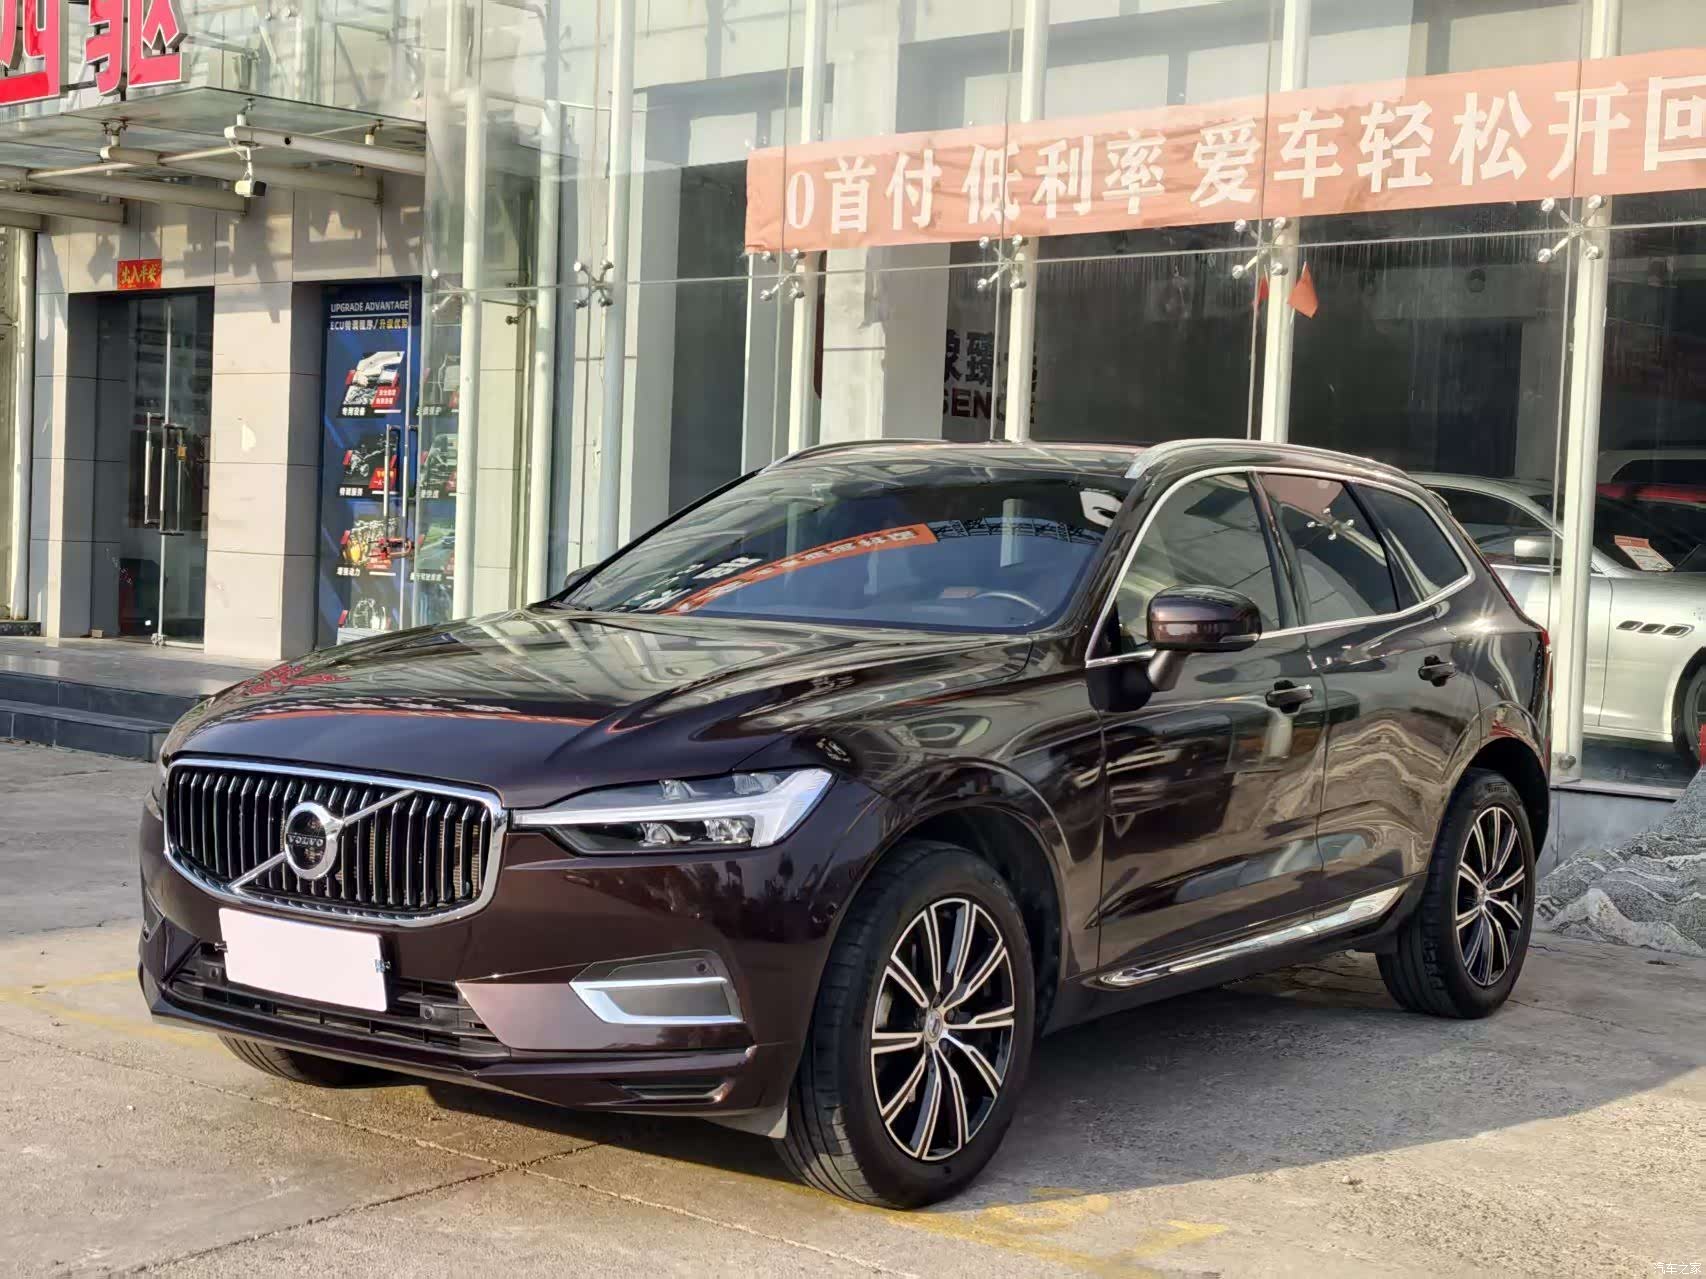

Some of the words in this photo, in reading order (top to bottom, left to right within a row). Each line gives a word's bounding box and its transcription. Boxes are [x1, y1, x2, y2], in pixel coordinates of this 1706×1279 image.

[121, 263, 157, 285] 出入平安
[330, 302, 364, 313] UPGRADE
[364, 300, 409, 311] ADVANTAGE
[287, 834, 324, 847] VOLVO
